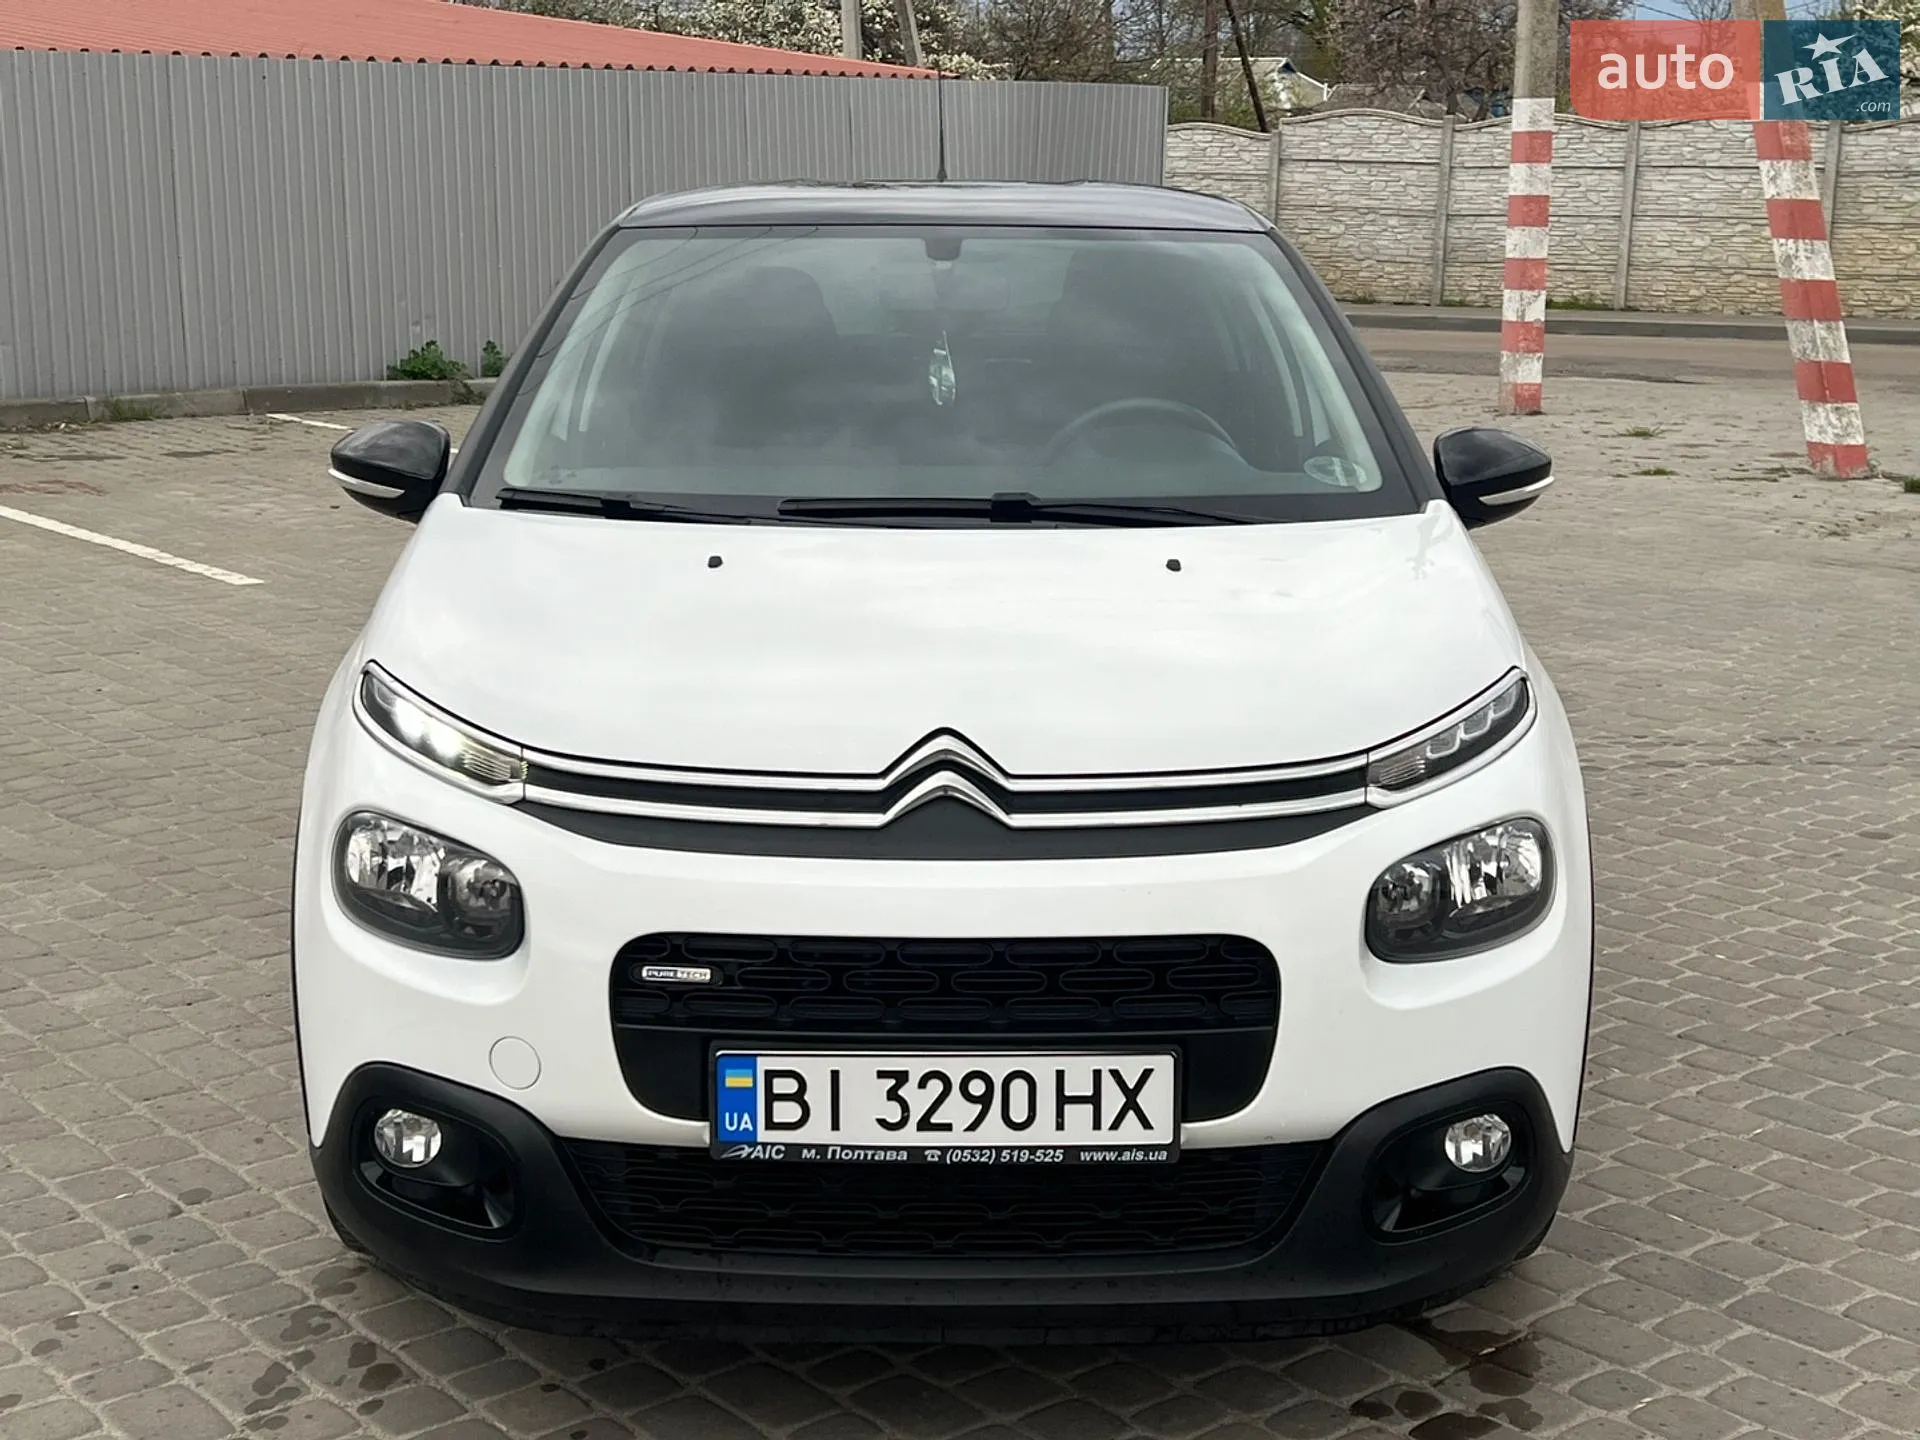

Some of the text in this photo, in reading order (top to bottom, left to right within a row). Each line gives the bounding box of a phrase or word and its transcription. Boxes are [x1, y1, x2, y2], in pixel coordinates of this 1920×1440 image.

[763, 1067, 1155, 1132] BI 3290 HX
[724, 1111, 753, 1132] UA
[801, 1148, 821, 1160] м.
[826, 1145, 908, 1161] Полтава
[946, 1148, 996, 1165] (0532)
[999, 1149, 1064, 1163] 519-525
[1079, 1148, 1168, 1162] www.ais.ua
